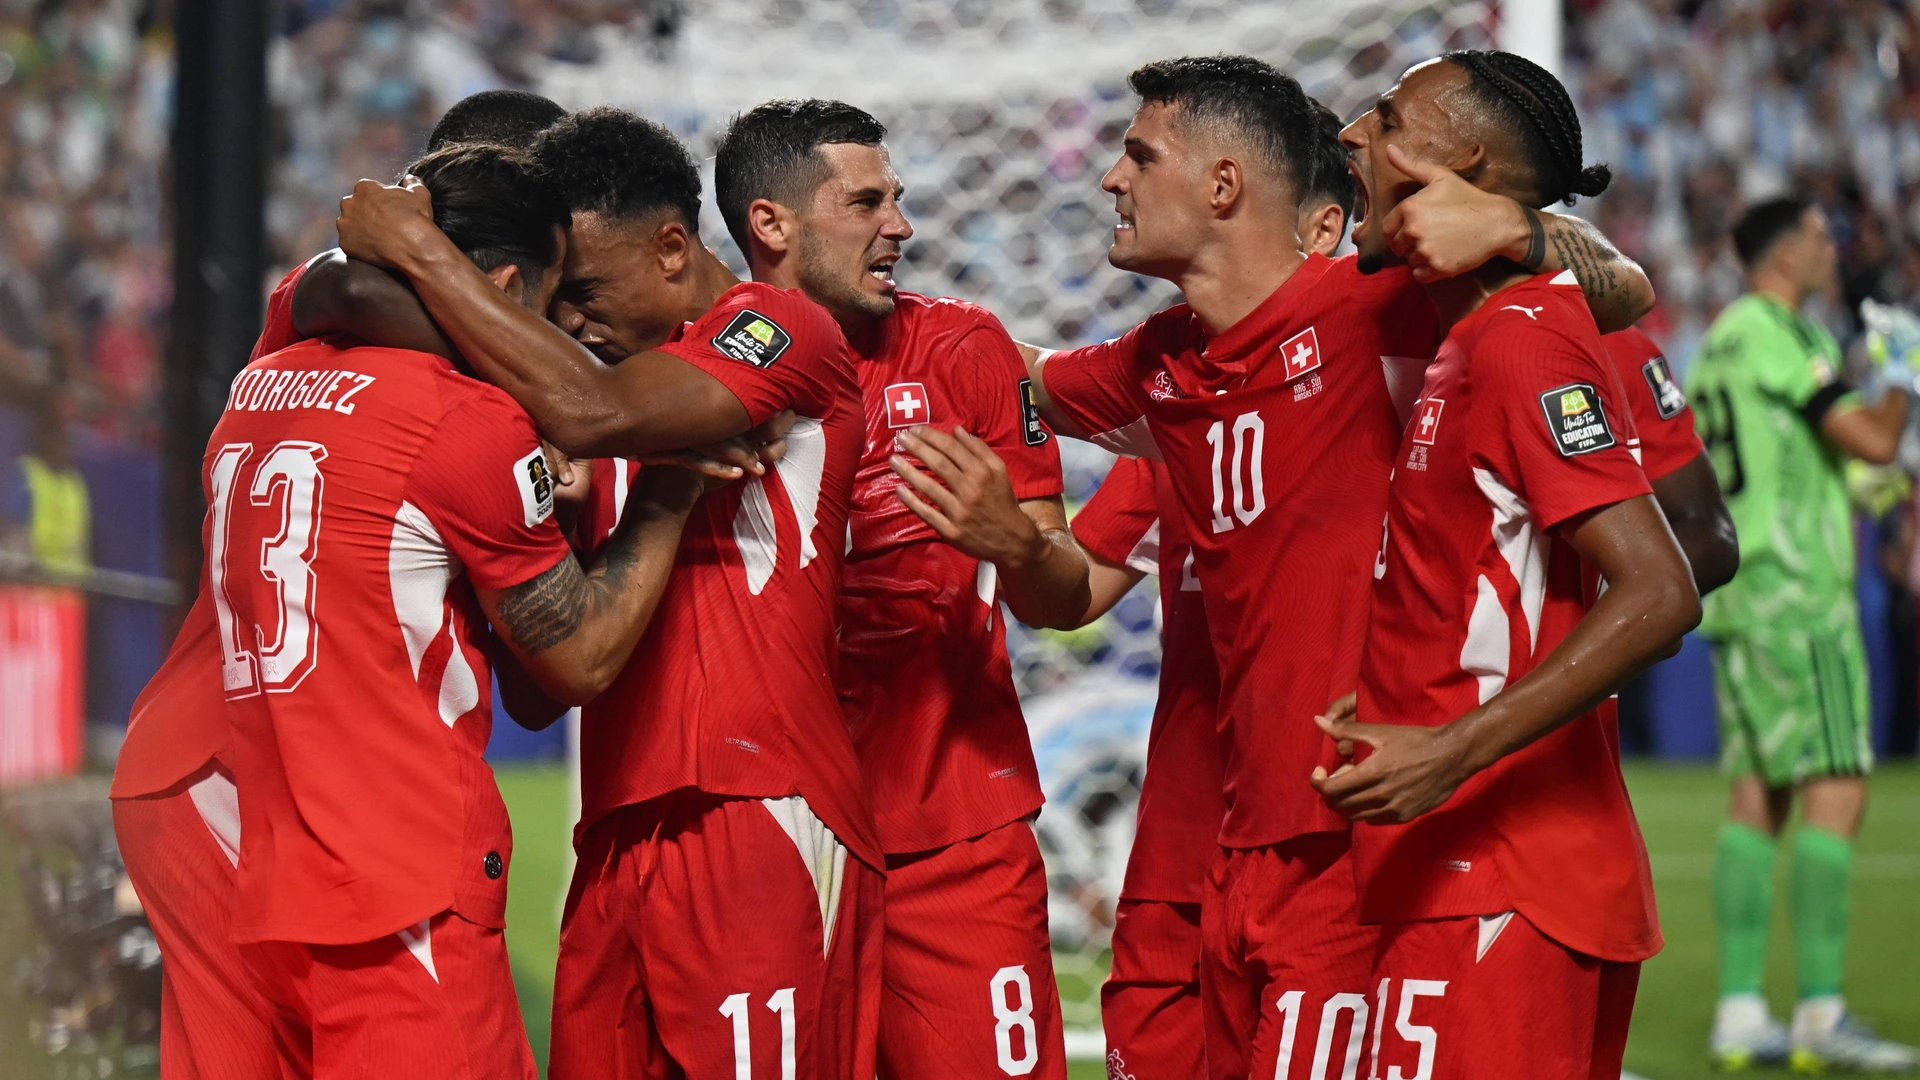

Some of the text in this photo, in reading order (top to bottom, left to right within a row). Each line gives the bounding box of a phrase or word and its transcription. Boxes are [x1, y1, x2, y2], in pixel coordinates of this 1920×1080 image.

[225, 368, 377, 416] RODRIGUEZ
[1561, 423, 1605, 444] EDUCATION
[1563, 411, 1595, 431] Unite For
[1205, 410, 1266, 534] 10
[1578, 438, 1596, 449] FIFA
[209, 440, 329, 702] 13
[718, 987, 797, 1080] 11
[990, 964, 1039, 1077] 8
[1274, 990, 1370, 1080] 10
[1368, 977, 1450, 1080] 15
